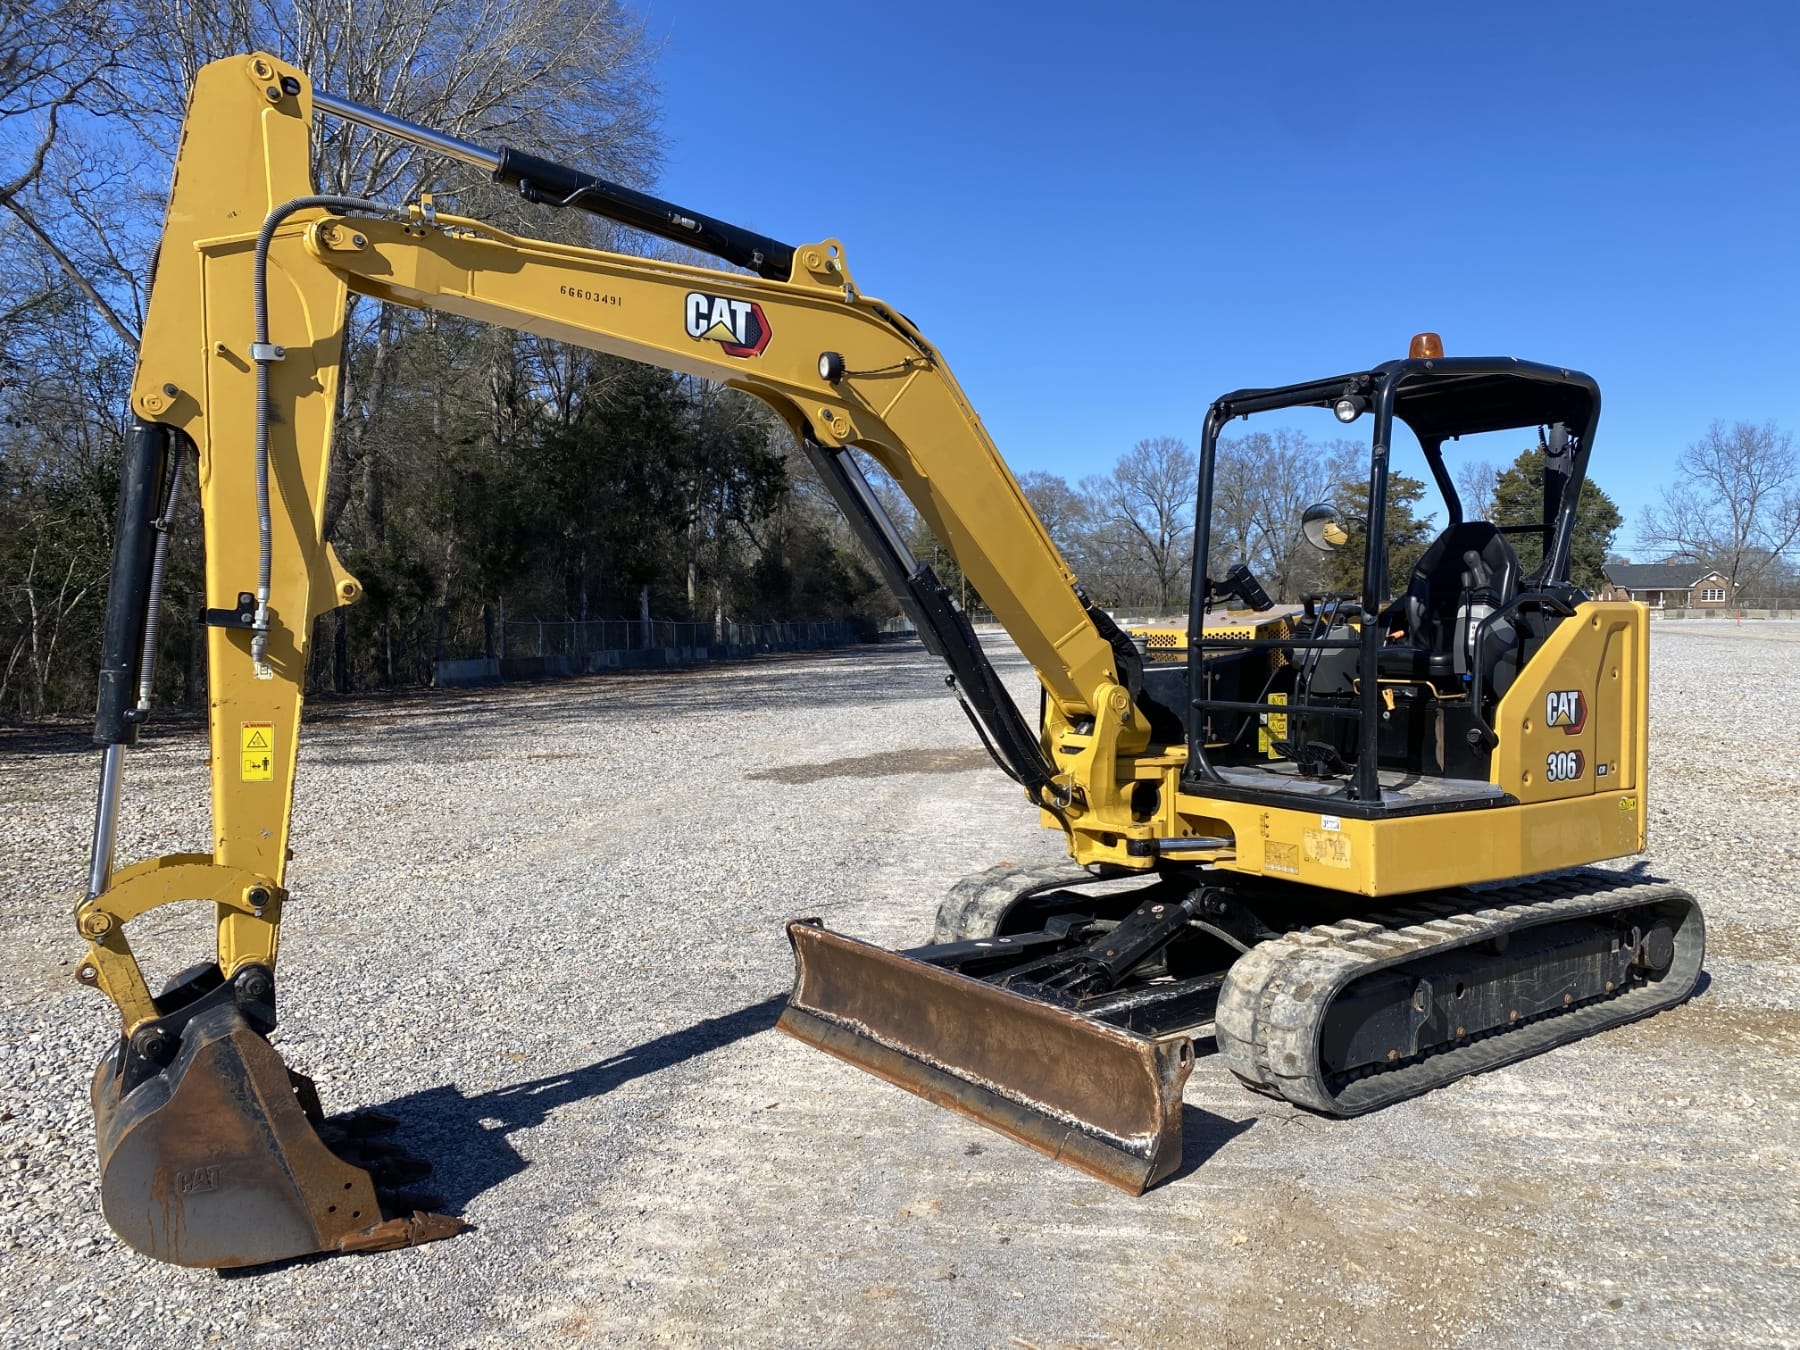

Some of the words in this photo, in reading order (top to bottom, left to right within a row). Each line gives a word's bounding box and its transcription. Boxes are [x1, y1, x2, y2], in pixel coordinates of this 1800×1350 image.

[686, 292, 752, 345] CAT
[1546, 691, 1579, 727] CAT
[1547, 752, 1577, 781] 306
[177, 1166, 220, 1193] CAT
